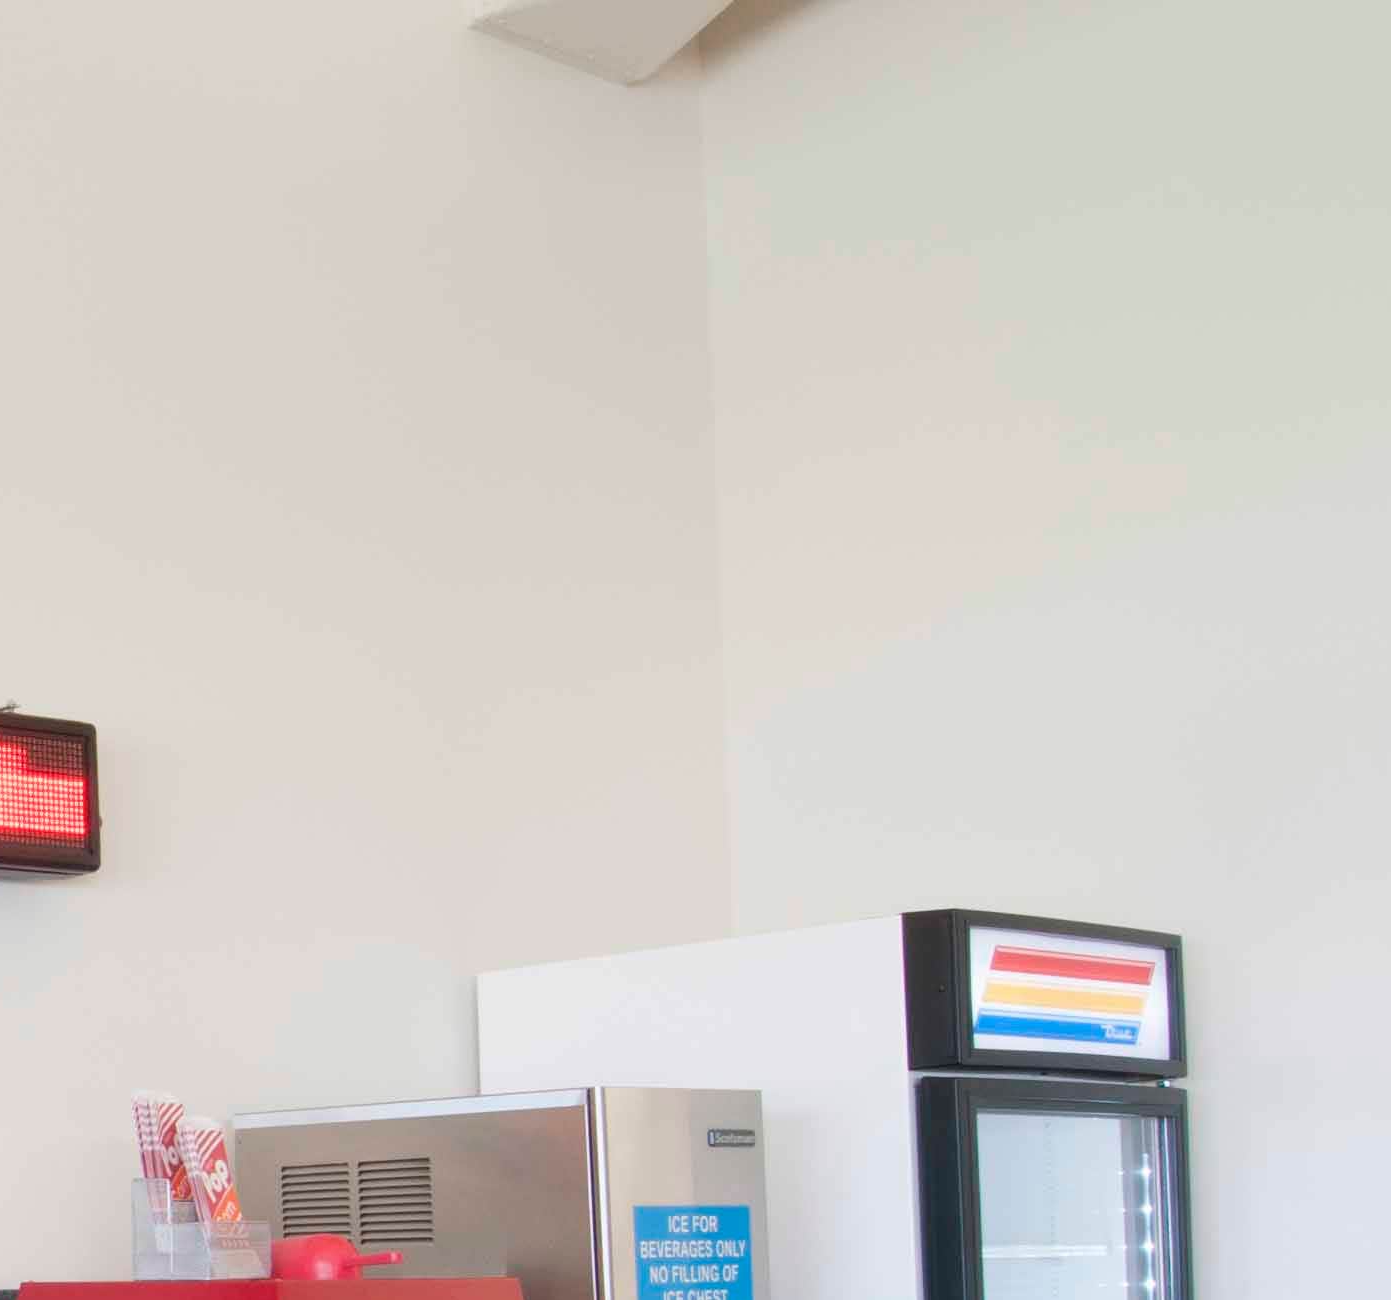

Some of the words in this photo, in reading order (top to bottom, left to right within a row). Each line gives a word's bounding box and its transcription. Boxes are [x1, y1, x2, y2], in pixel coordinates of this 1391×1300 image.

[668, 1215, 689, 1233] ICE
[692, 1215, 718, 1233] FOR
[640, 1240, 712, 1258] BEVERAGES
[716, 1240, 746, 1258] ONLY
[650, 1266, 669, 1284] NO
[672, 1265, 719, 1283] FILLING
[722, 1265, 739, 1282] OF
